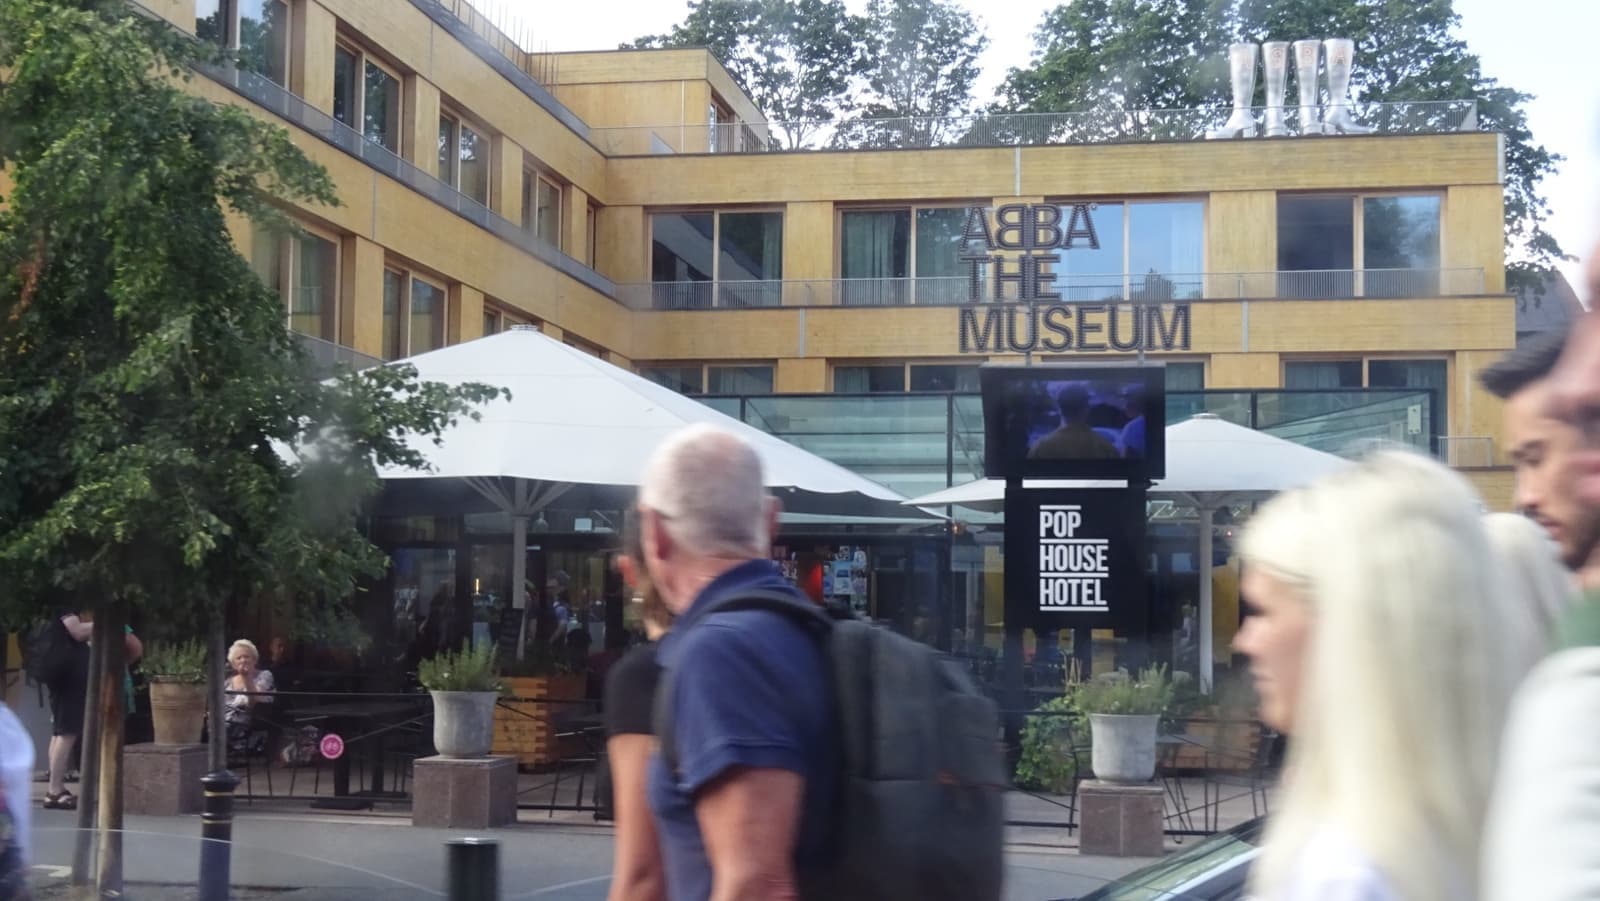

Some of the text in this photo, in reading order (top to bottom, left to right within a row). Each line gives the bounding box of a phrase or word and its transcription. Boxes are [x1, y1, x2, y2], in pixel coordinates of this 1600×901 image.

[959, 254, 1062, 300] THE
[959, 303, 1191, 353] MUSEUM
[1039, 511, 1082, 537] POP
[1039, 545, 1109, 571] HOUSE
[1039, 578, 1107, 605] HOTEL
